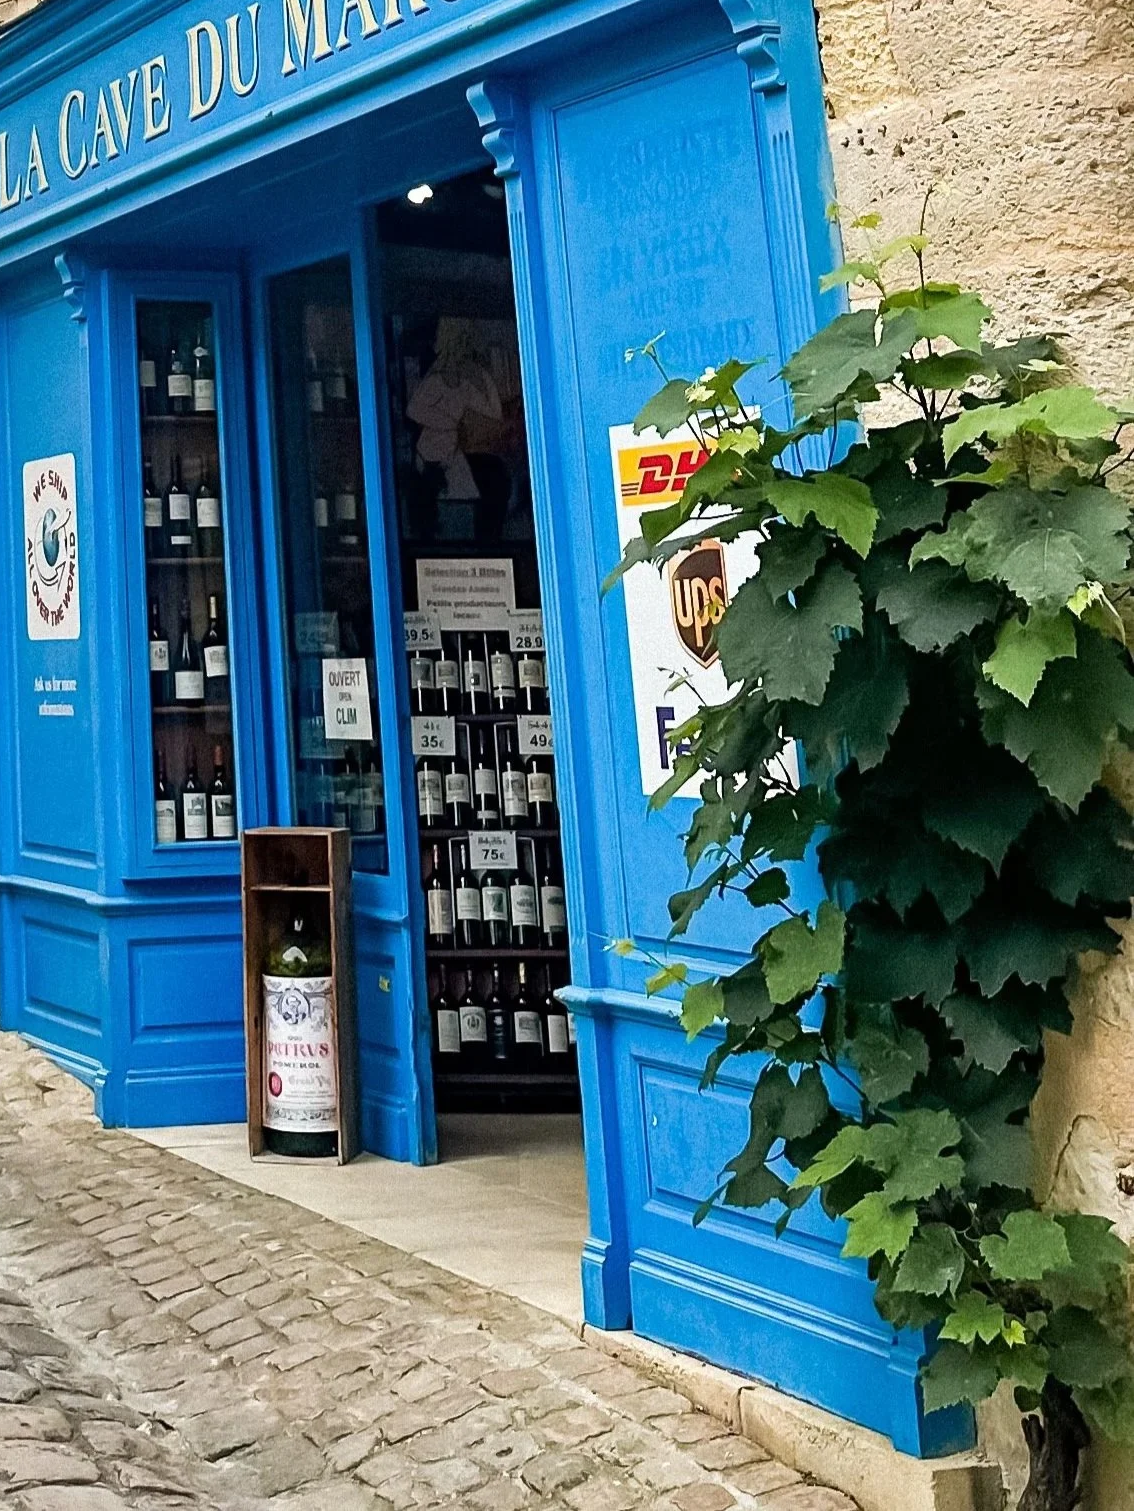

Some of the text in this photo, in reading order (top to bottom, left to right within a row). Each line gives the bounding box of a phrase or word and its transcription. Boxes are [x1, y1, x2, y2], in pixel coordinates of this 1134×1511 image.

[58, 55, 170, 180] CAVE
[186, 3, 260, 120] DU
[33, 469, 68, 502] WE SHIP
[638, 449, 712, 494] DH
[27, 531, 76, 626] ALL OVER THE WORLD
[674, 576, 726, 647] ups
[328, 670, 360, 687] OUVERT
[339, 692, 352, 701] OPEN
[336, 707, 357, 725] CLIM
